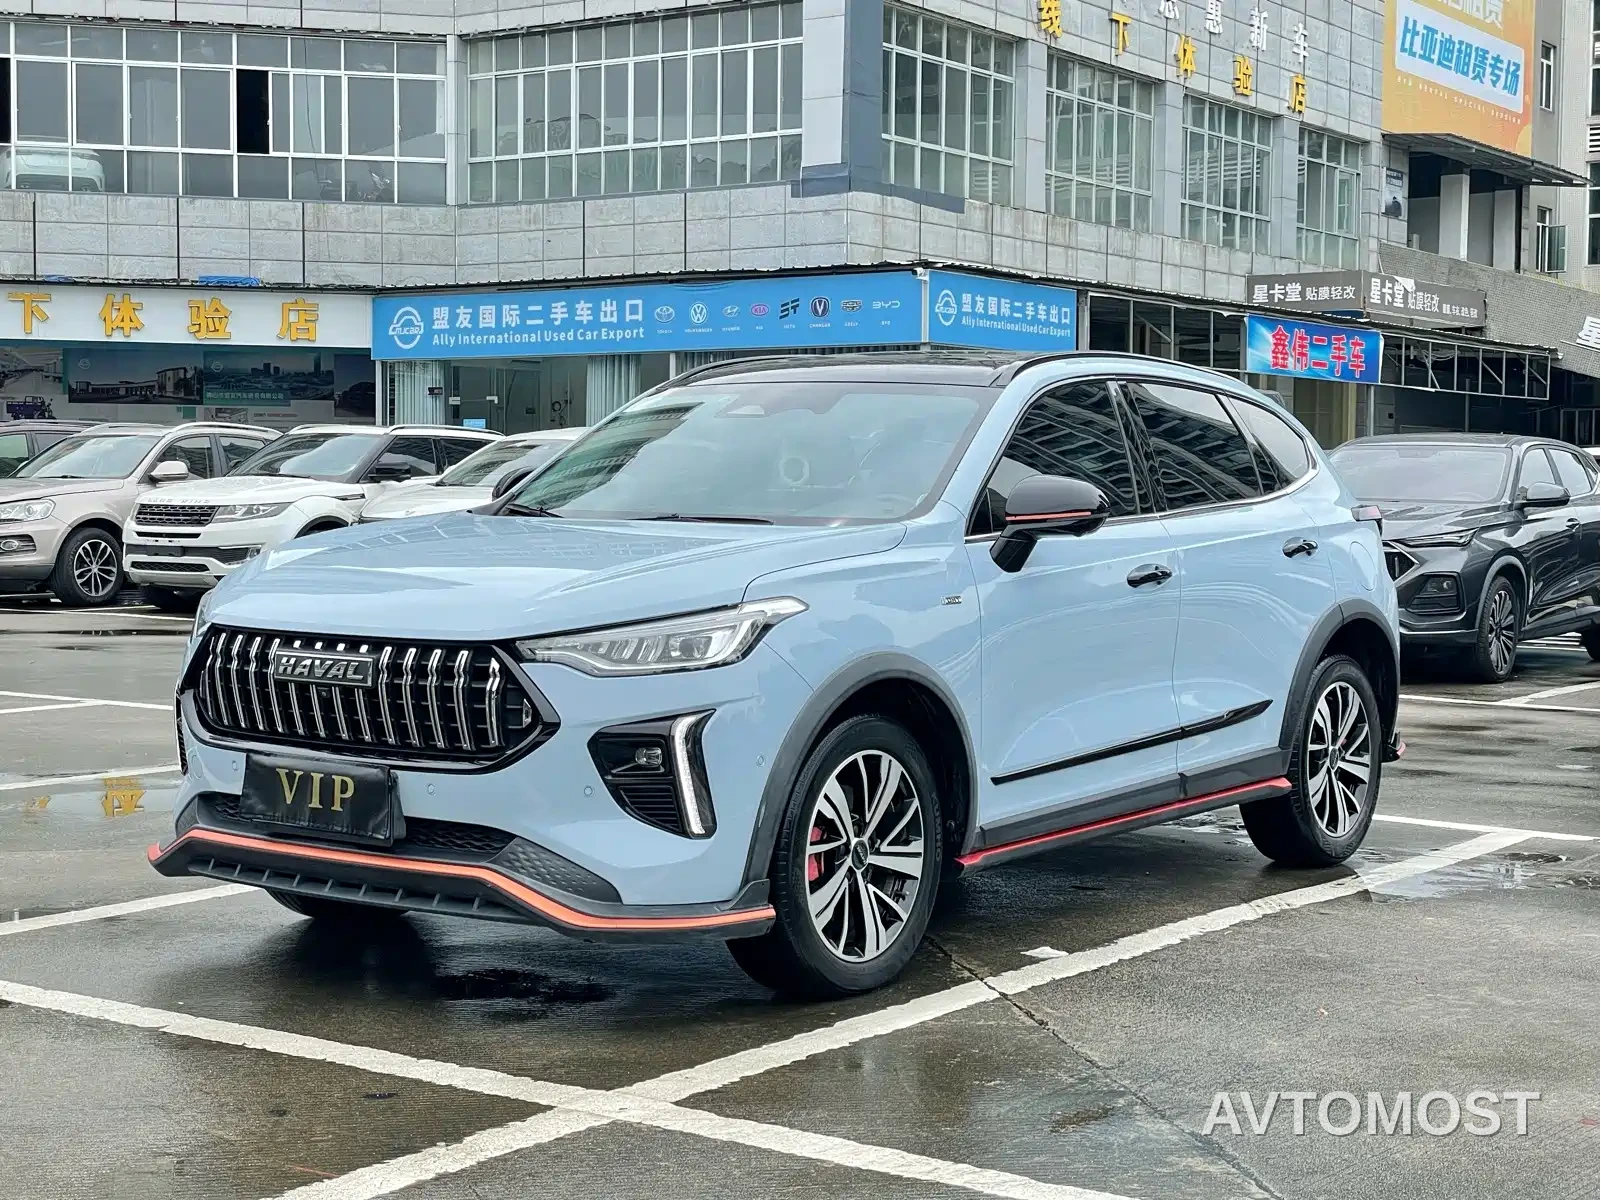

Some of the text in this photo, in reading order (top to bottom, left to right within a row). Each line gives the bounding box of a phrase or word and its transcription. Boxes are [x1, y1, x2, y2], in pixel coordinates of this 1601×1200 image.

[1039, 0, 1306, 114] 线下体验店
[1399, 16, 1521, 97] 比亚迪租赁专场
[1252, 282, 1356, 303] 星卡堂 贴膜轻改
[1370, 277, 1404, 308] 星卡堂
[8, 291, 319, 342] 下体验店
[432, 298, 643, 330] 盟友国际二手车出口
[961, 293, 1071, 325] 盟友国际二手车出口
[433, 326, 645, 347] Ally International Used Car Export
[961, 315, 1071, 338] Ally International Used Car Export
[1270, 323, 1366, 379] 鑫伟二手车
[278, 656, 365, 681] HAVAL
[276, 767, 355, 812] VIP
